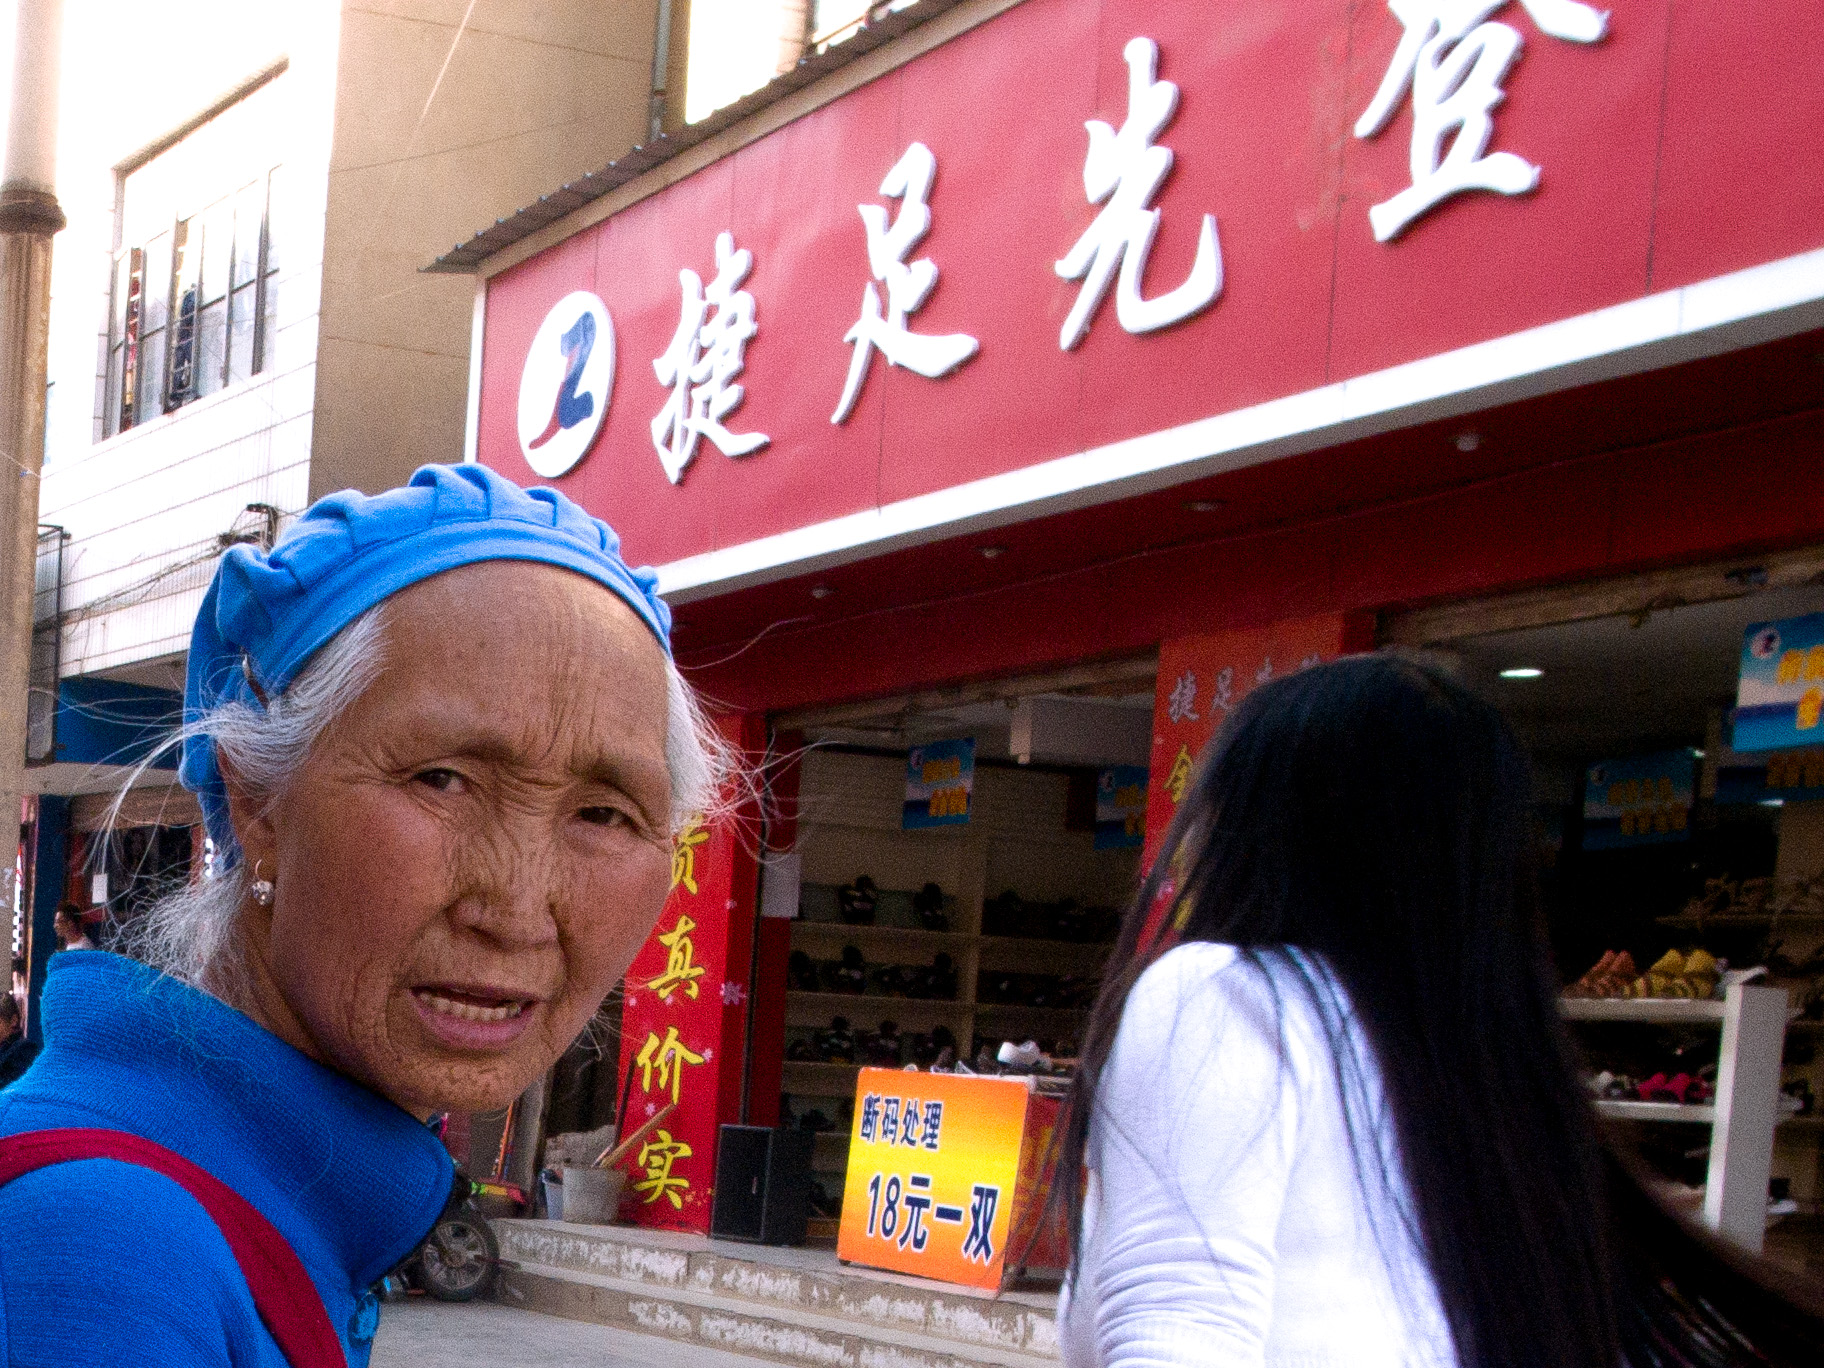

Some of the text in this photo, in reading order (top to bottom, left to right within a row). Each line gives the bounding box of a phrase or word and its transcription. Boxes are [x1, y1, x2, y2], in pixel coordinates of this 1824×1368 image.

[651, 0, 1610, 485] 捷足先登
[860, 1091, 943, 1150] 断码处理
[867, 1173, 999, 1266] 18元一双
